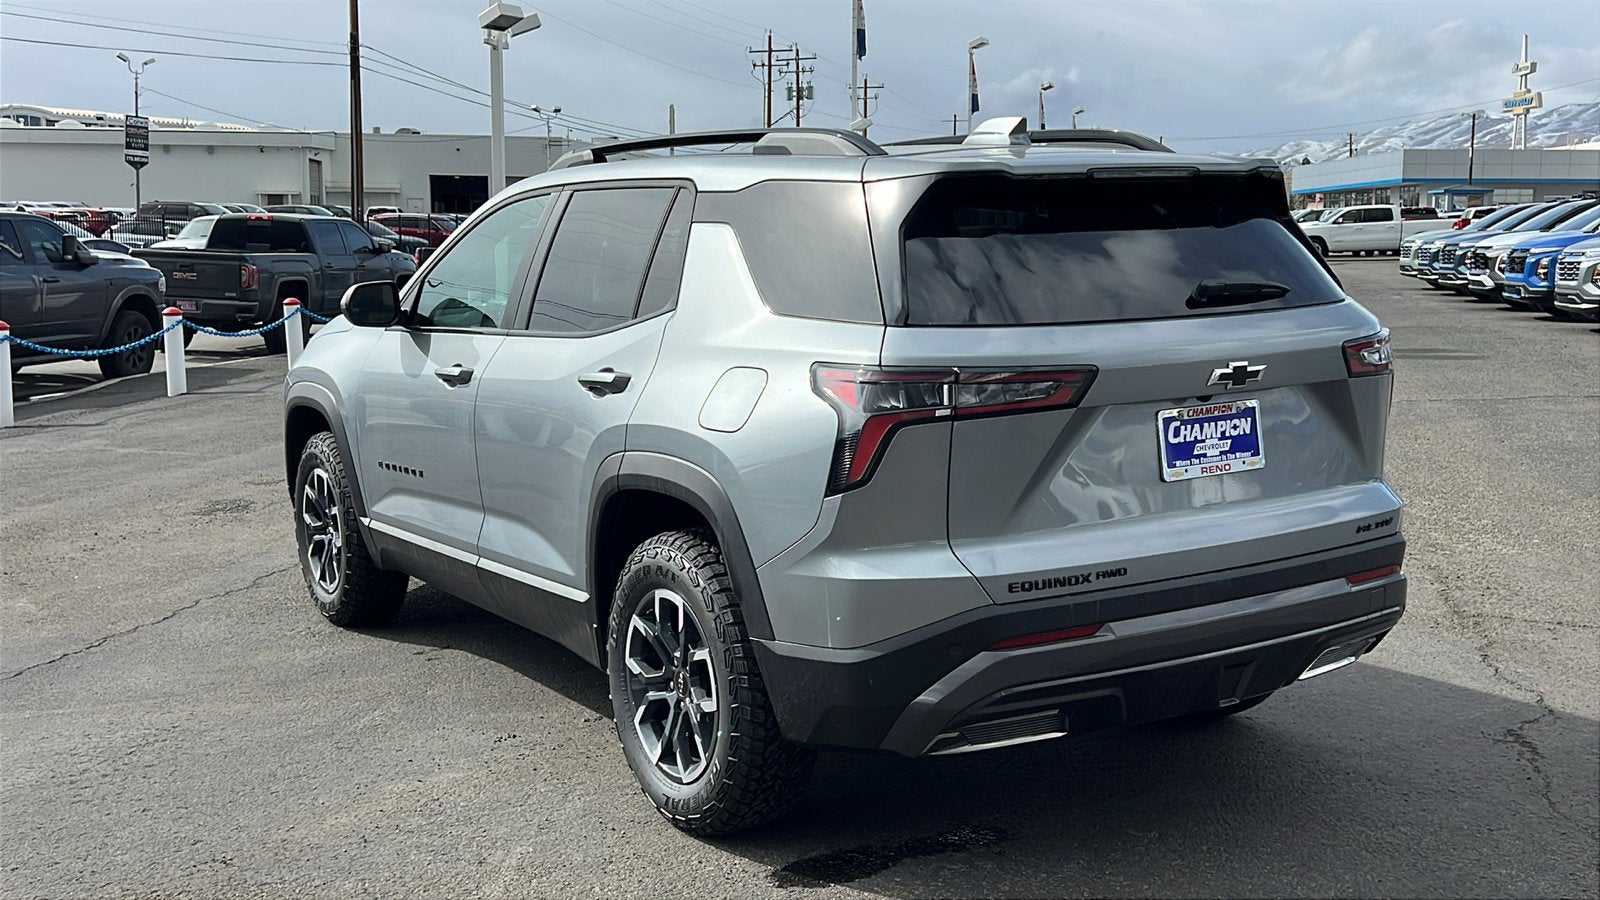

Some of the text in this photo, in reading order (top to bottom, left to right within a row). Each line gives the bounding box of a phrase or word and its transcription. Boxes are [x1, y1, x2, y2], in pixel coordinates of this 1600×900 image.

[172, 272, 197, 280] GMC
[1187, 404, 1234, 418] CHAMPION
[1168, 418, 1251, 444] CHAMPION
[1196, 442, 1229, 452] CHEVROLET
[1201, 464, 1231, 475] RENO
[1008, 568, 1128, 593] EQUINOX AWD
